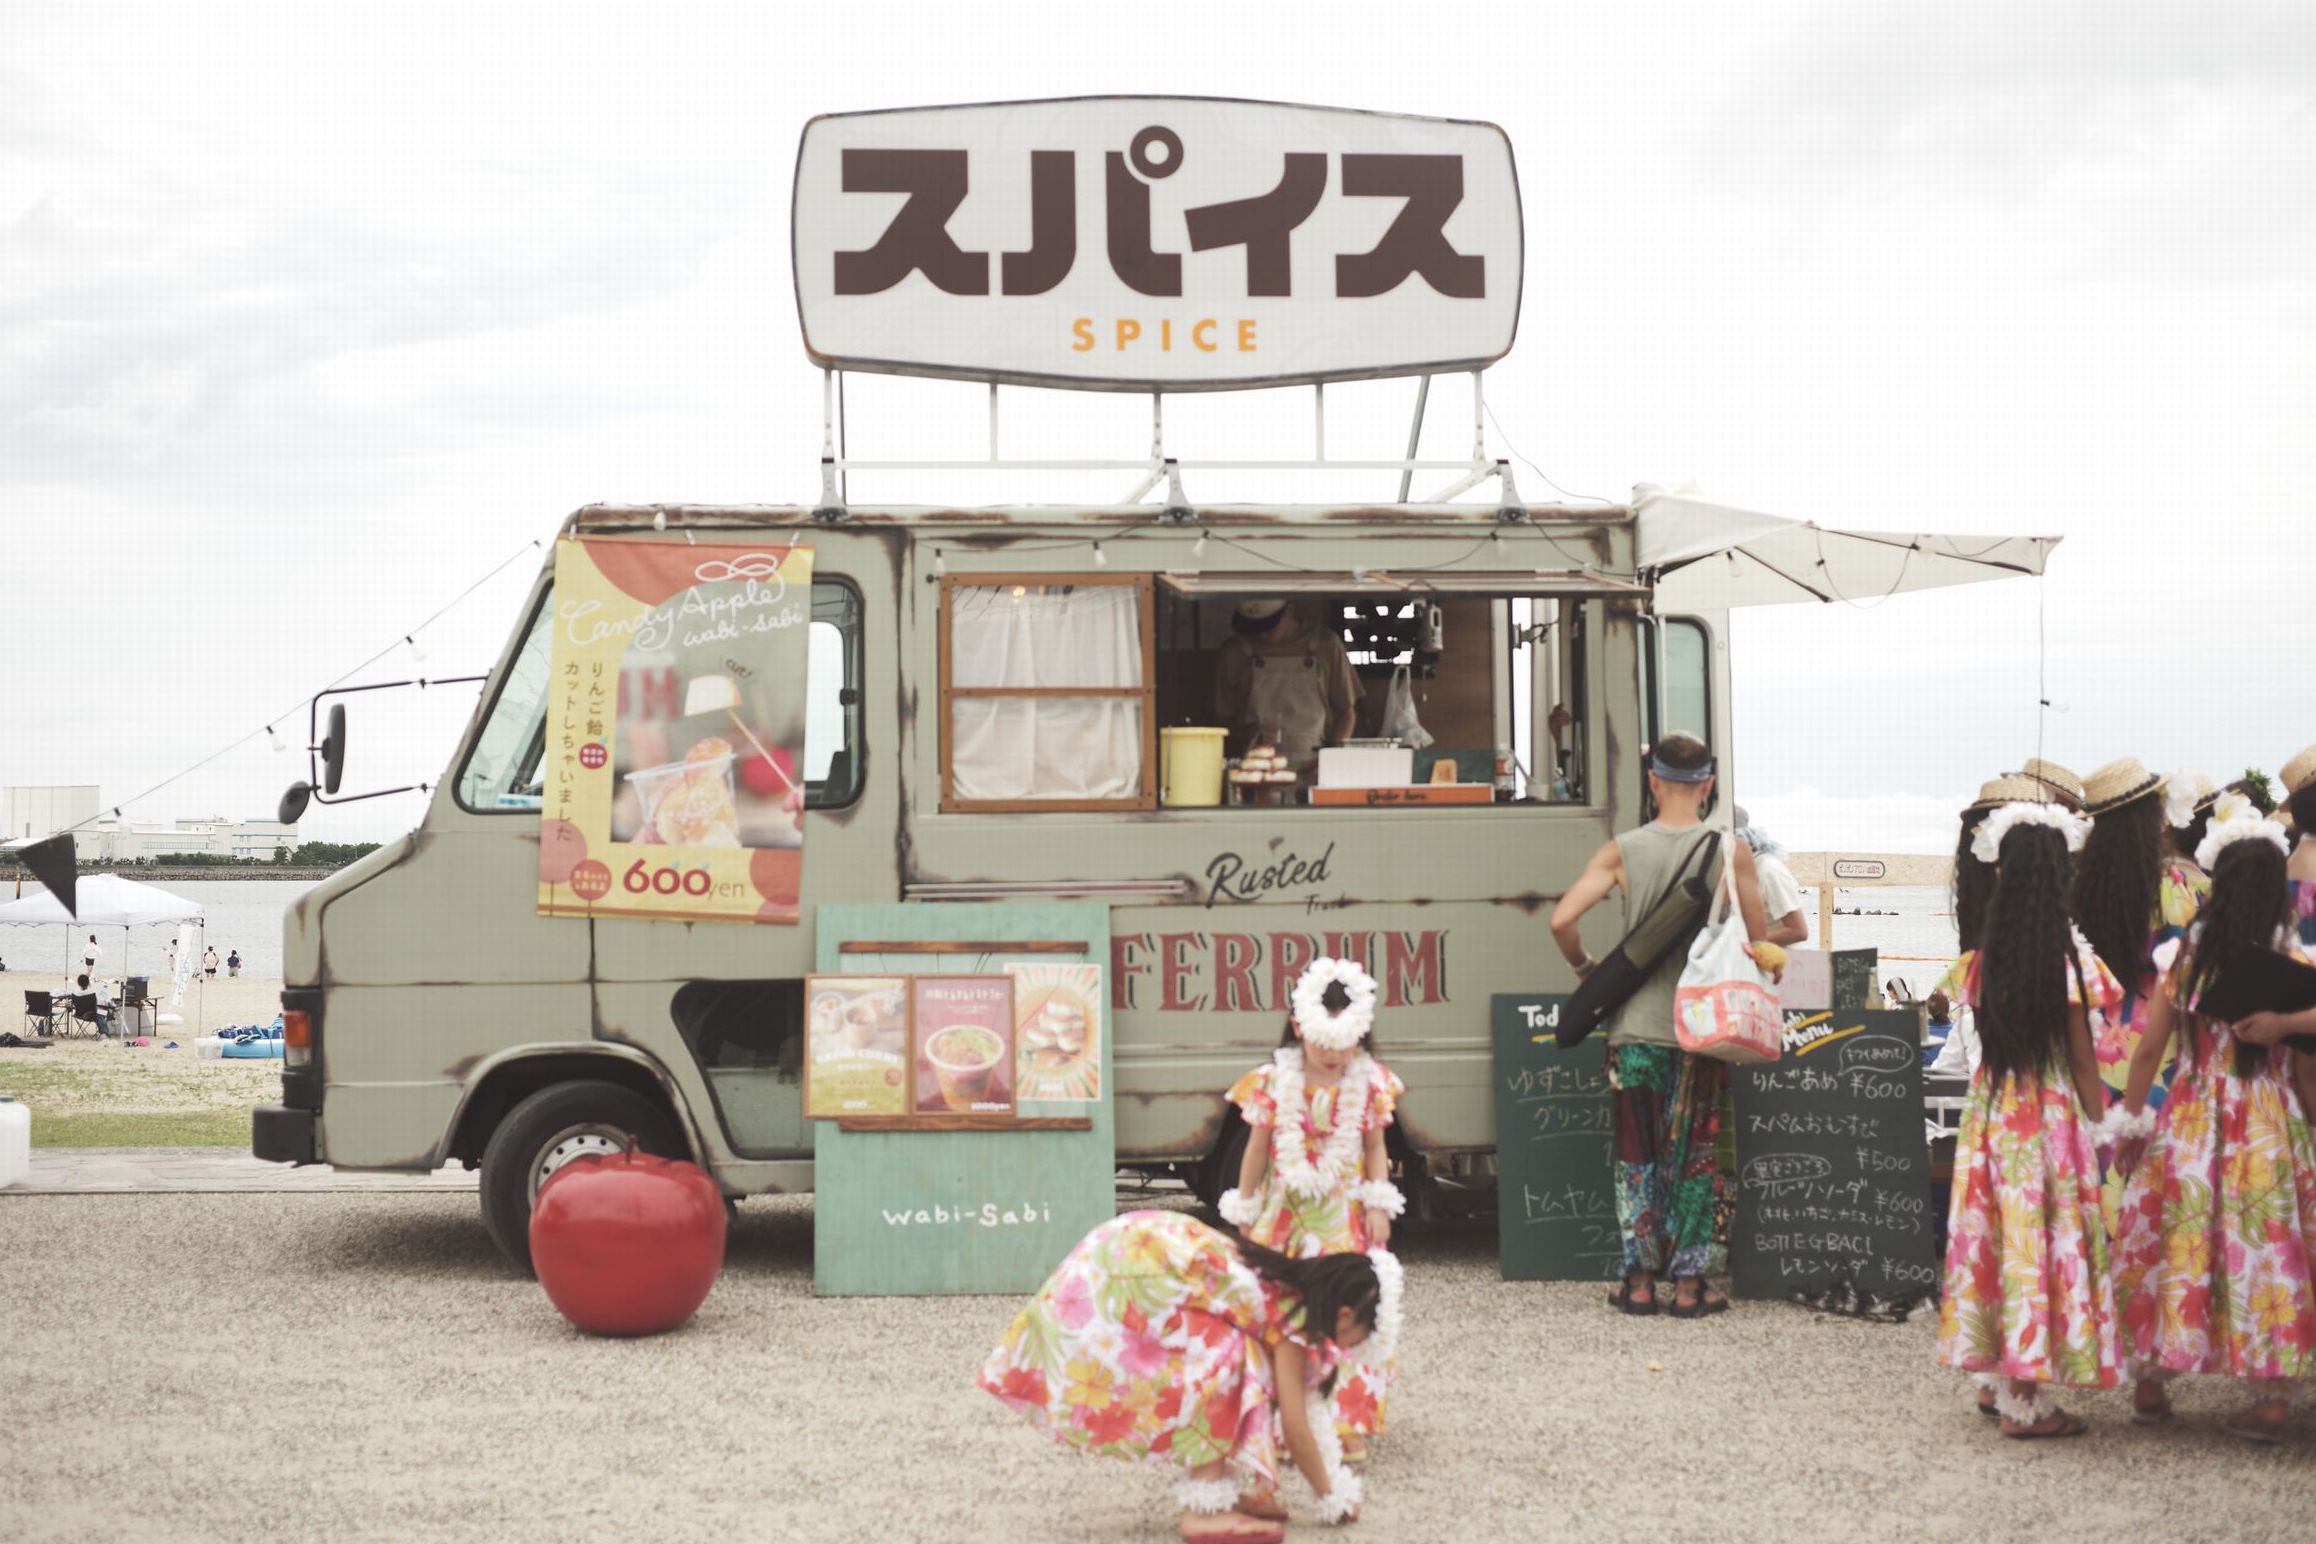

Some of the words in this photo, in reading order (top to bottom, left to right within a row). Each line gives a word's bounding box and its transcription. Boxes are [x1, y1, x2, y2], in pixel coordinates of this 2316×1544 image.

[834, 125, 1486, 299] スパイス
[1071, 318, 1258, 352] SPICE
[559, 598, 674, 653] Candy
[678, 552, 786, 621] Apple
[683, 604, 803, 648] wabi-sabi
[587, 661, 605, 737] りんご飴
[556, 660, 579, 843] カットしちゃいました
[623, 857, 711, 897] 600
[706, 881, 745, 901] yen
[1205, 841, 1335, 910] Rusted
[1752, 1067, 1839, 1092] りんごあめ
[1850, 1072, 1908, 1100] ¥600
[1748, 1112, 1880, 1138] スパムおむすび
[1856, 1145, 1912, 1172] ¥500
[881, 1201, 1050, 1227] wabi-Sabi
[1874, 1187, 1924, 1214] ¥600
[1780, 1257, 1868, 1279] レモンソーダ
[1880, 1256, 1936, 1284] ¥600
